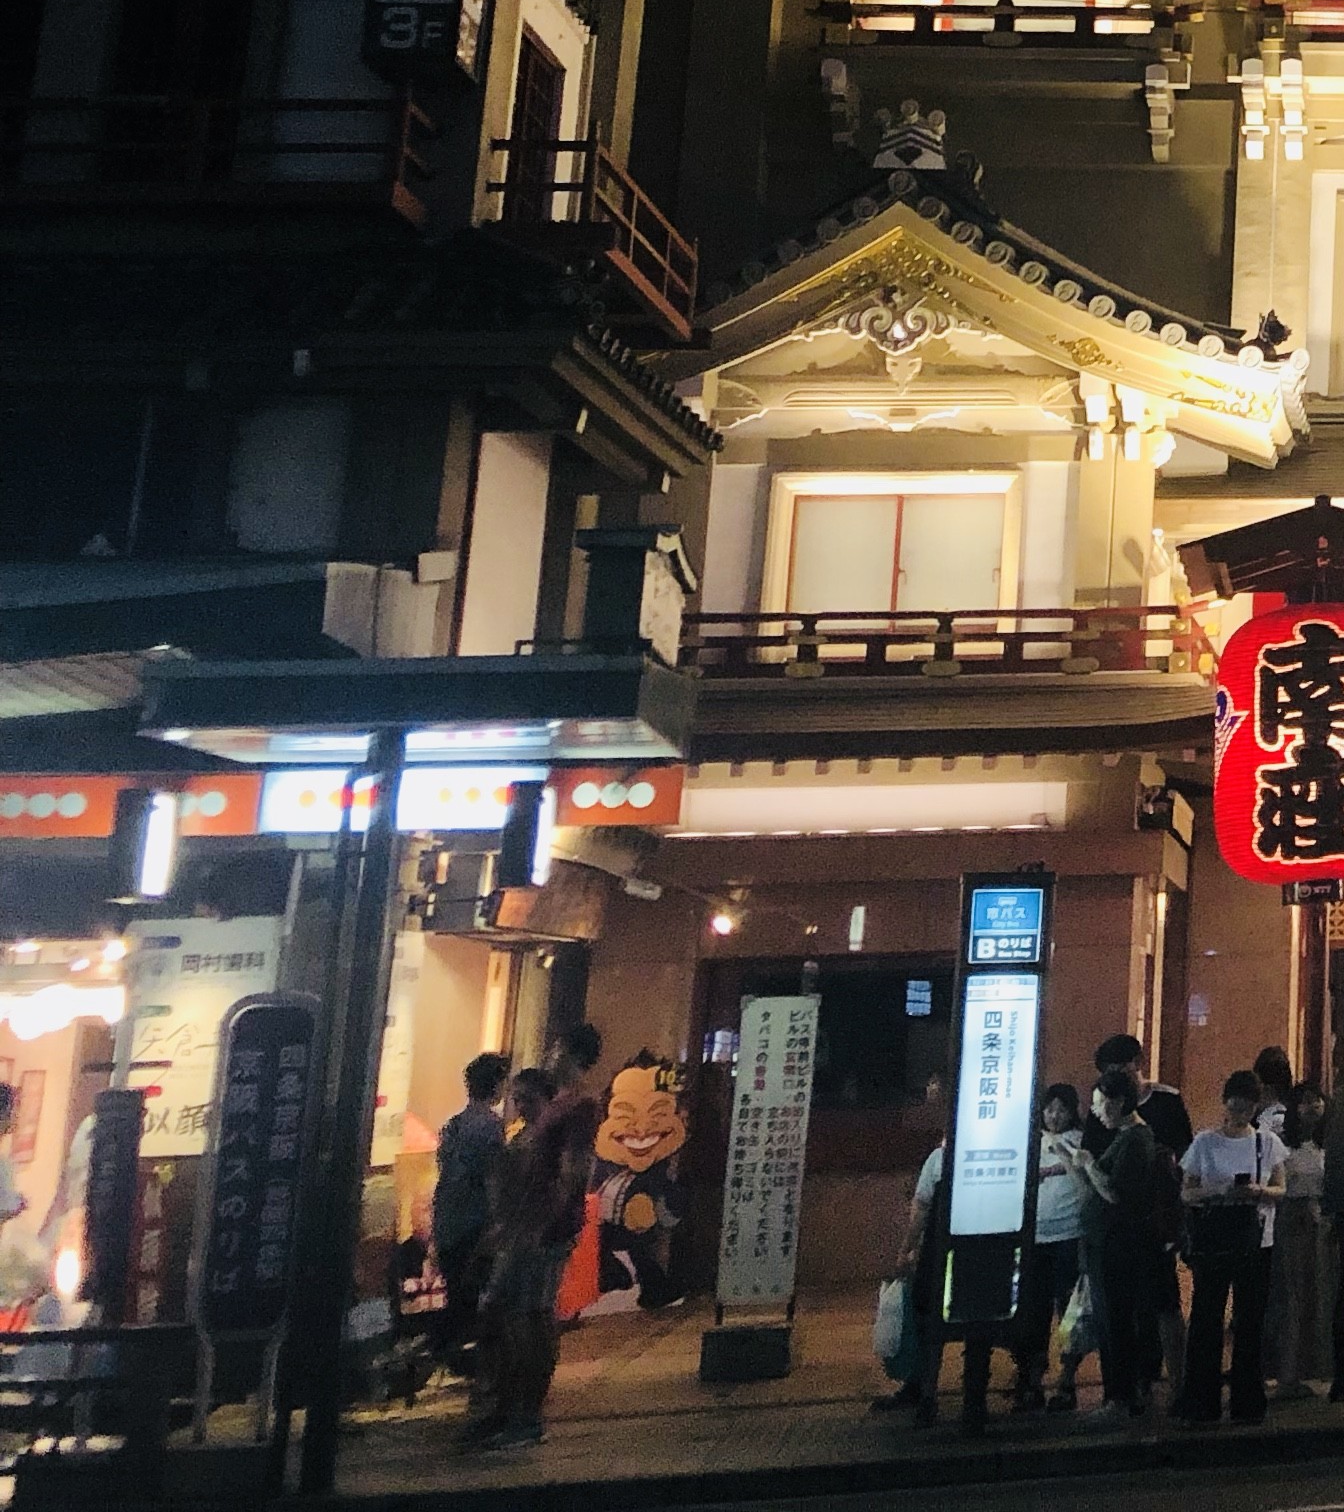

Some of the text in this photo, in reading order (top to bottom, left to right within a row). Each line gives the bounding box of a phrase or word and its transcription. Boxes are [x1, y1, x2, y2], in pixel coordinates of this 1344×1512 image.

[380, 5, 446, 51] 3F
[986, 907, 1027, 920] 市バス
[976, 936, 1033, 959] B のりば
[978, 1010, 1003, 1120] 四条京阪前
